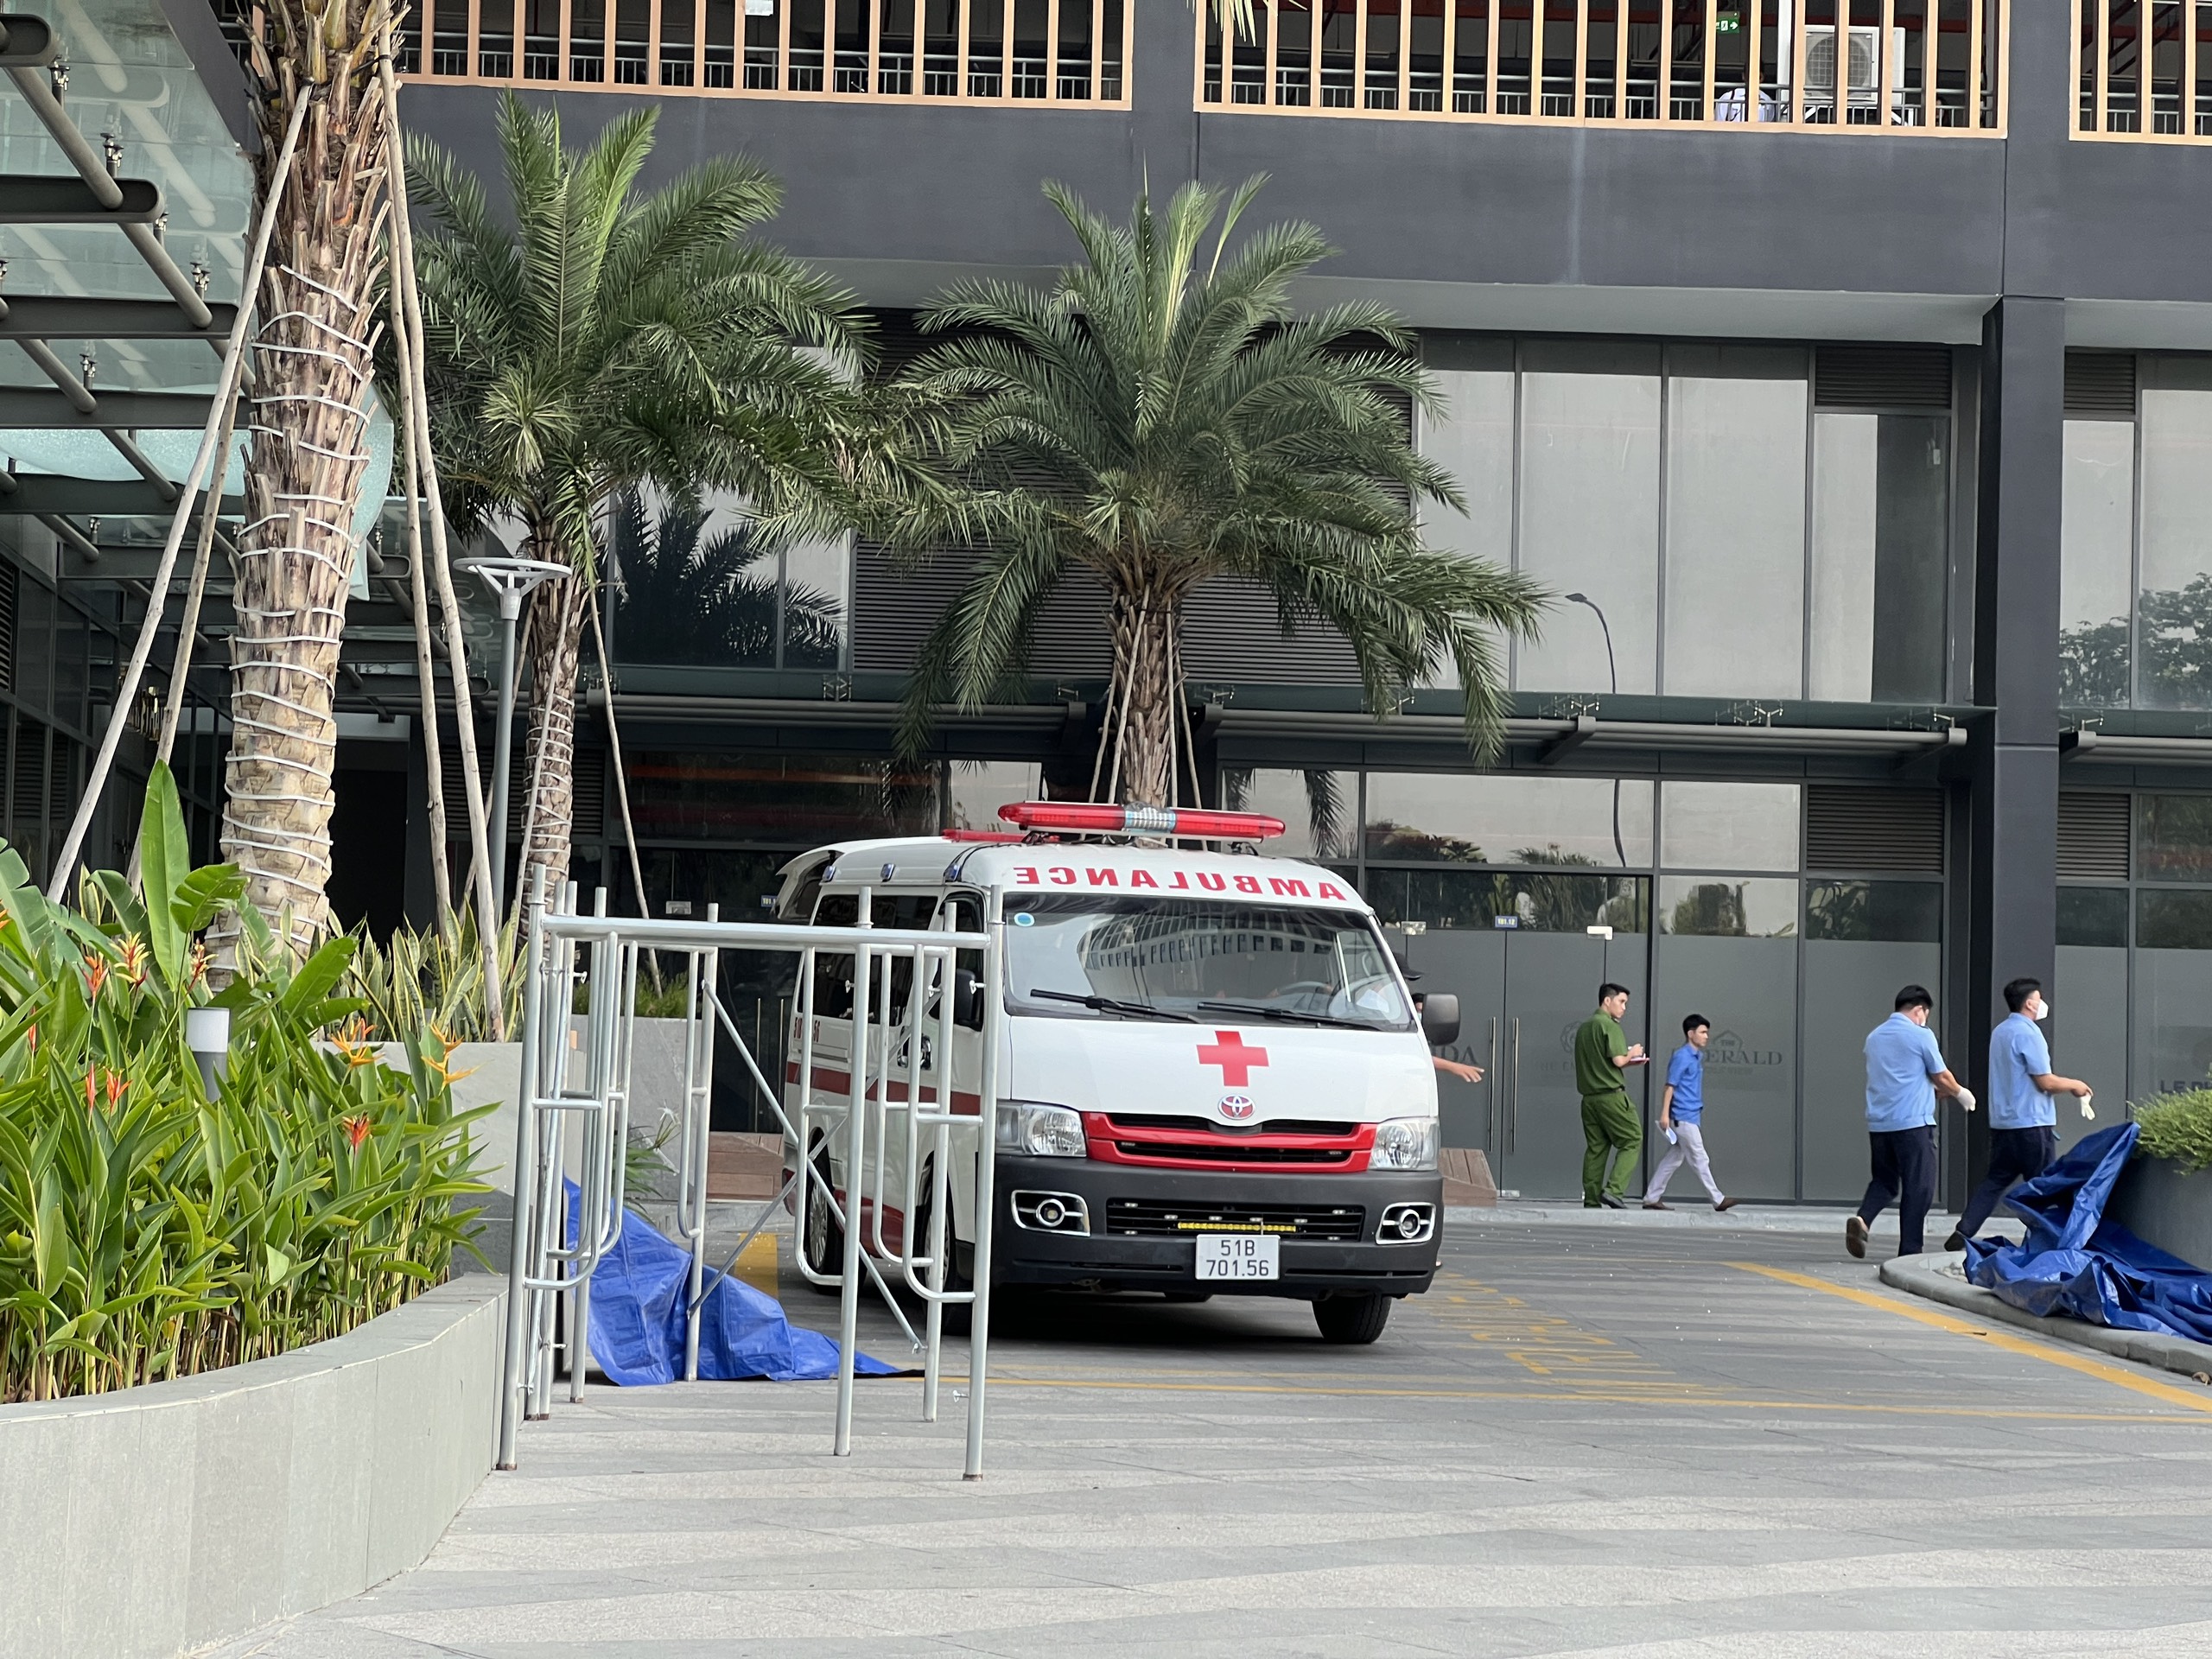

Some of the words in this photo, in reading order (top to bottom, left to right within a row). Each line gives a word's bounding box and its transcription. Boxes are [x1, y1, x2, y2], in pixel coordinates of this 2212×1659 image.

[1703, 1048, 1783, 1065] ERALD
[1220, 1239, 1255, 1257] 51B
[1205, 1259, 1269, 1278] 701.56
